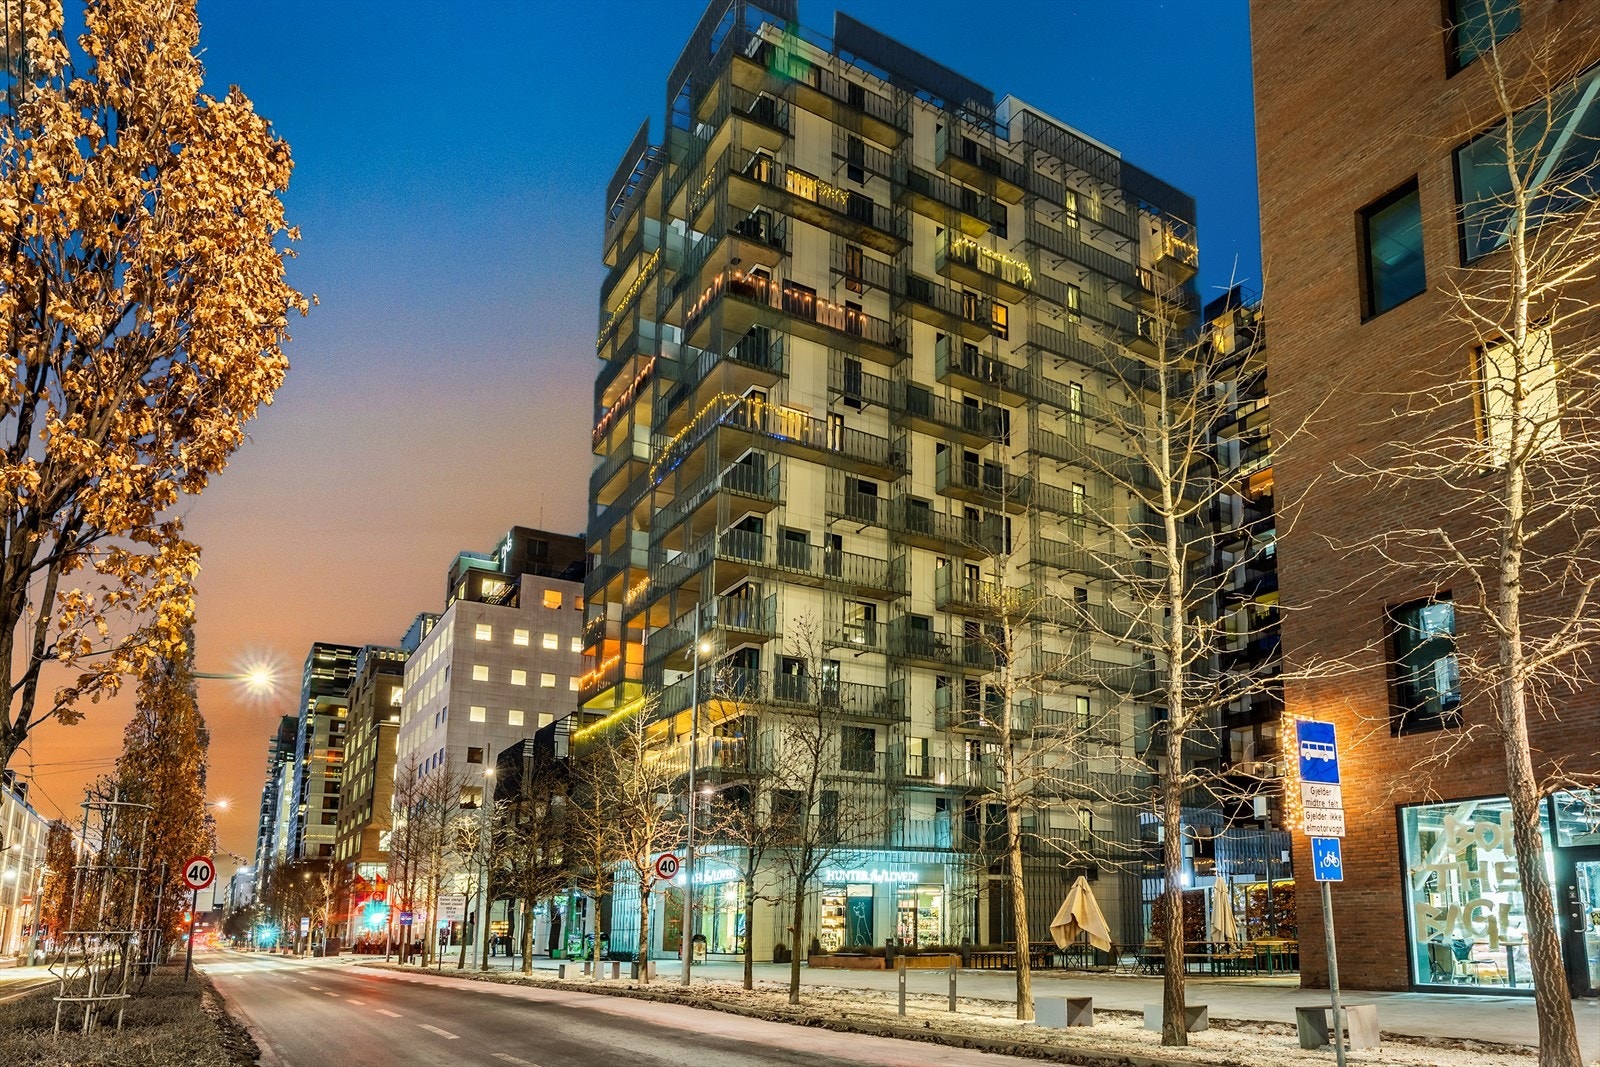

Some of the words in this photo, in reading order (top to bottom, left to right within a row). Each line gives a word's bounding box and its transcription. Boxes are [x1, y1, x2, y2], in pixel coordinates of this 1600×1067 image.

[1310, 786, 1332, 797] Gjelder
[1305, 798, 1325, 807] midtre
[1305, 811, 1327, 822] Gjelder
[1329, 812, 1342, 821] ikke
[660, 860, 676, 873] 40
[188, 865, 210, 881] 40
[1425, 860, 1521, 893] THE
